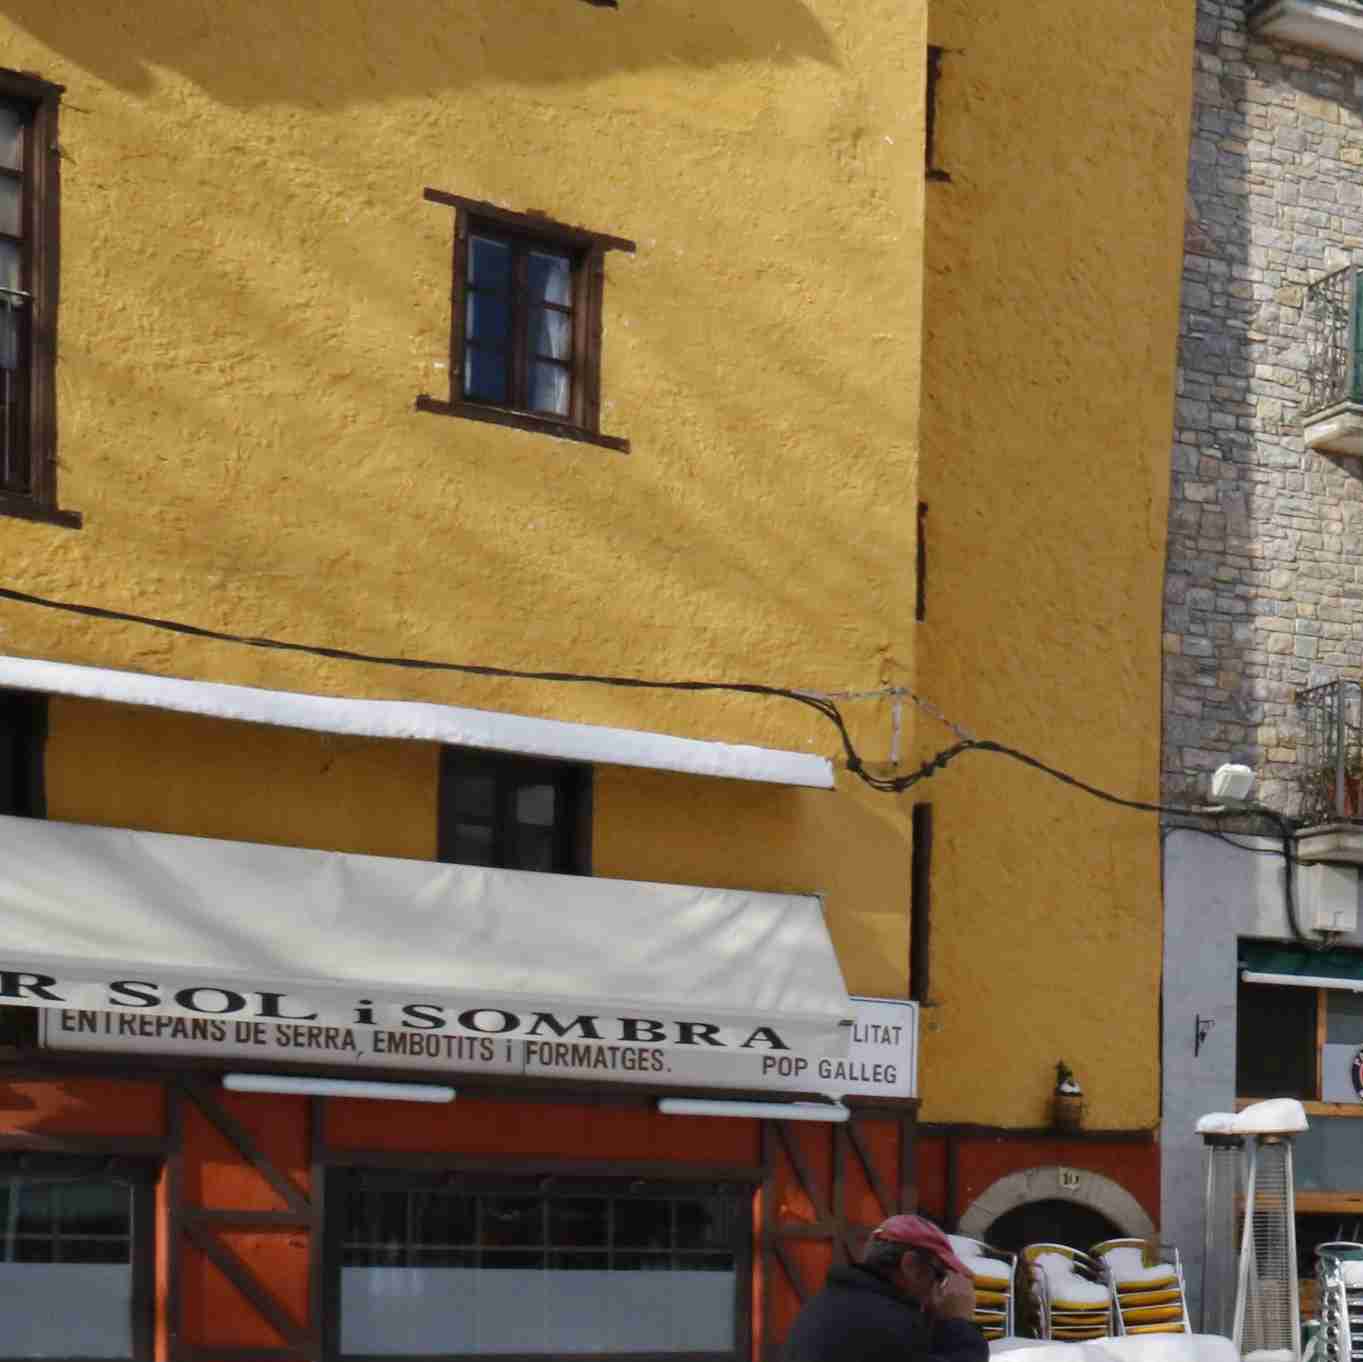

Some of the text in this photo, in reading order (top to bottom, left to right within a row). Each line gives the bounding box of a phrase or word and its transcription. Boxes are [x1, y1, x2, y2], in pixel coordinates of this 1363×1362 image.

[60, 1008, 228, 1043] ENTREPANS
[235, 1020, 267, 1045] DE
[372, 1029, 495, 1063] EMBOTITS
[505, 1041, 512, 1063] i
[108, 979, 318, 1021] SOL
[353, 999, 377, 1025] i
[401, 1003, 791, 1051] SOMBRA
[852, 1022, 902, 1047] LITAT
[762, 1054, 897, 1085] POP GALLEG
